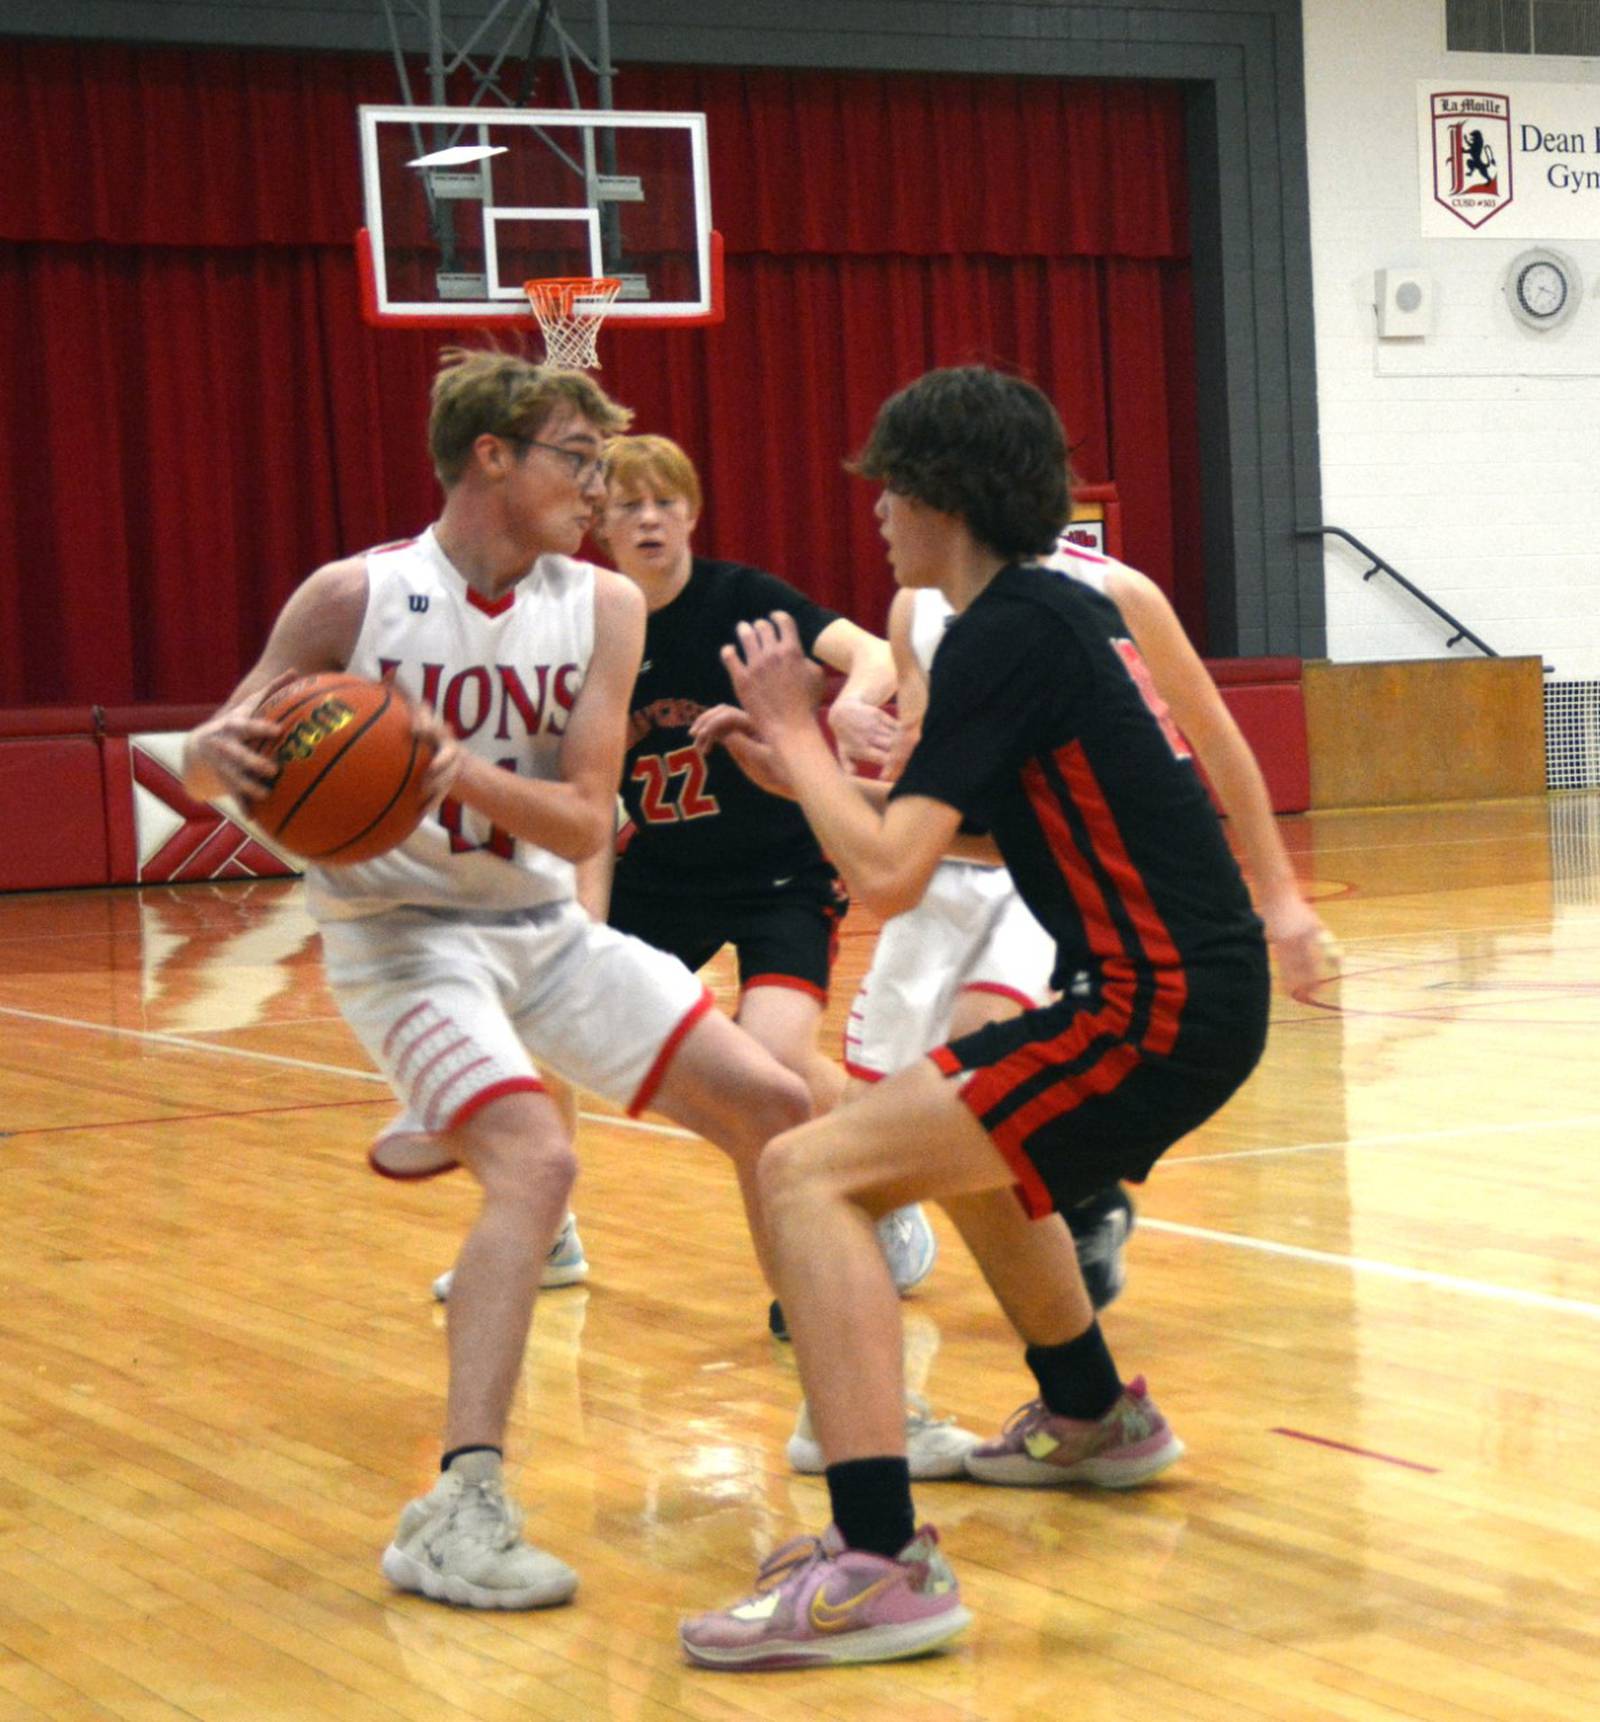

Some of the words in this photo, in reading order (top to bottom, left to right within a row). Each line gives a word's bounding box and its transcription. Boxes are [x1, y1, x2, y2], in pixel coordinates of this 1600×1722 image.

[1461, 98, 1501, 113] Moille
[1520, 124, 1586, 153] Dean
[379, 658, 578, 741] IONS
[631, 744, 721, 824] 22
